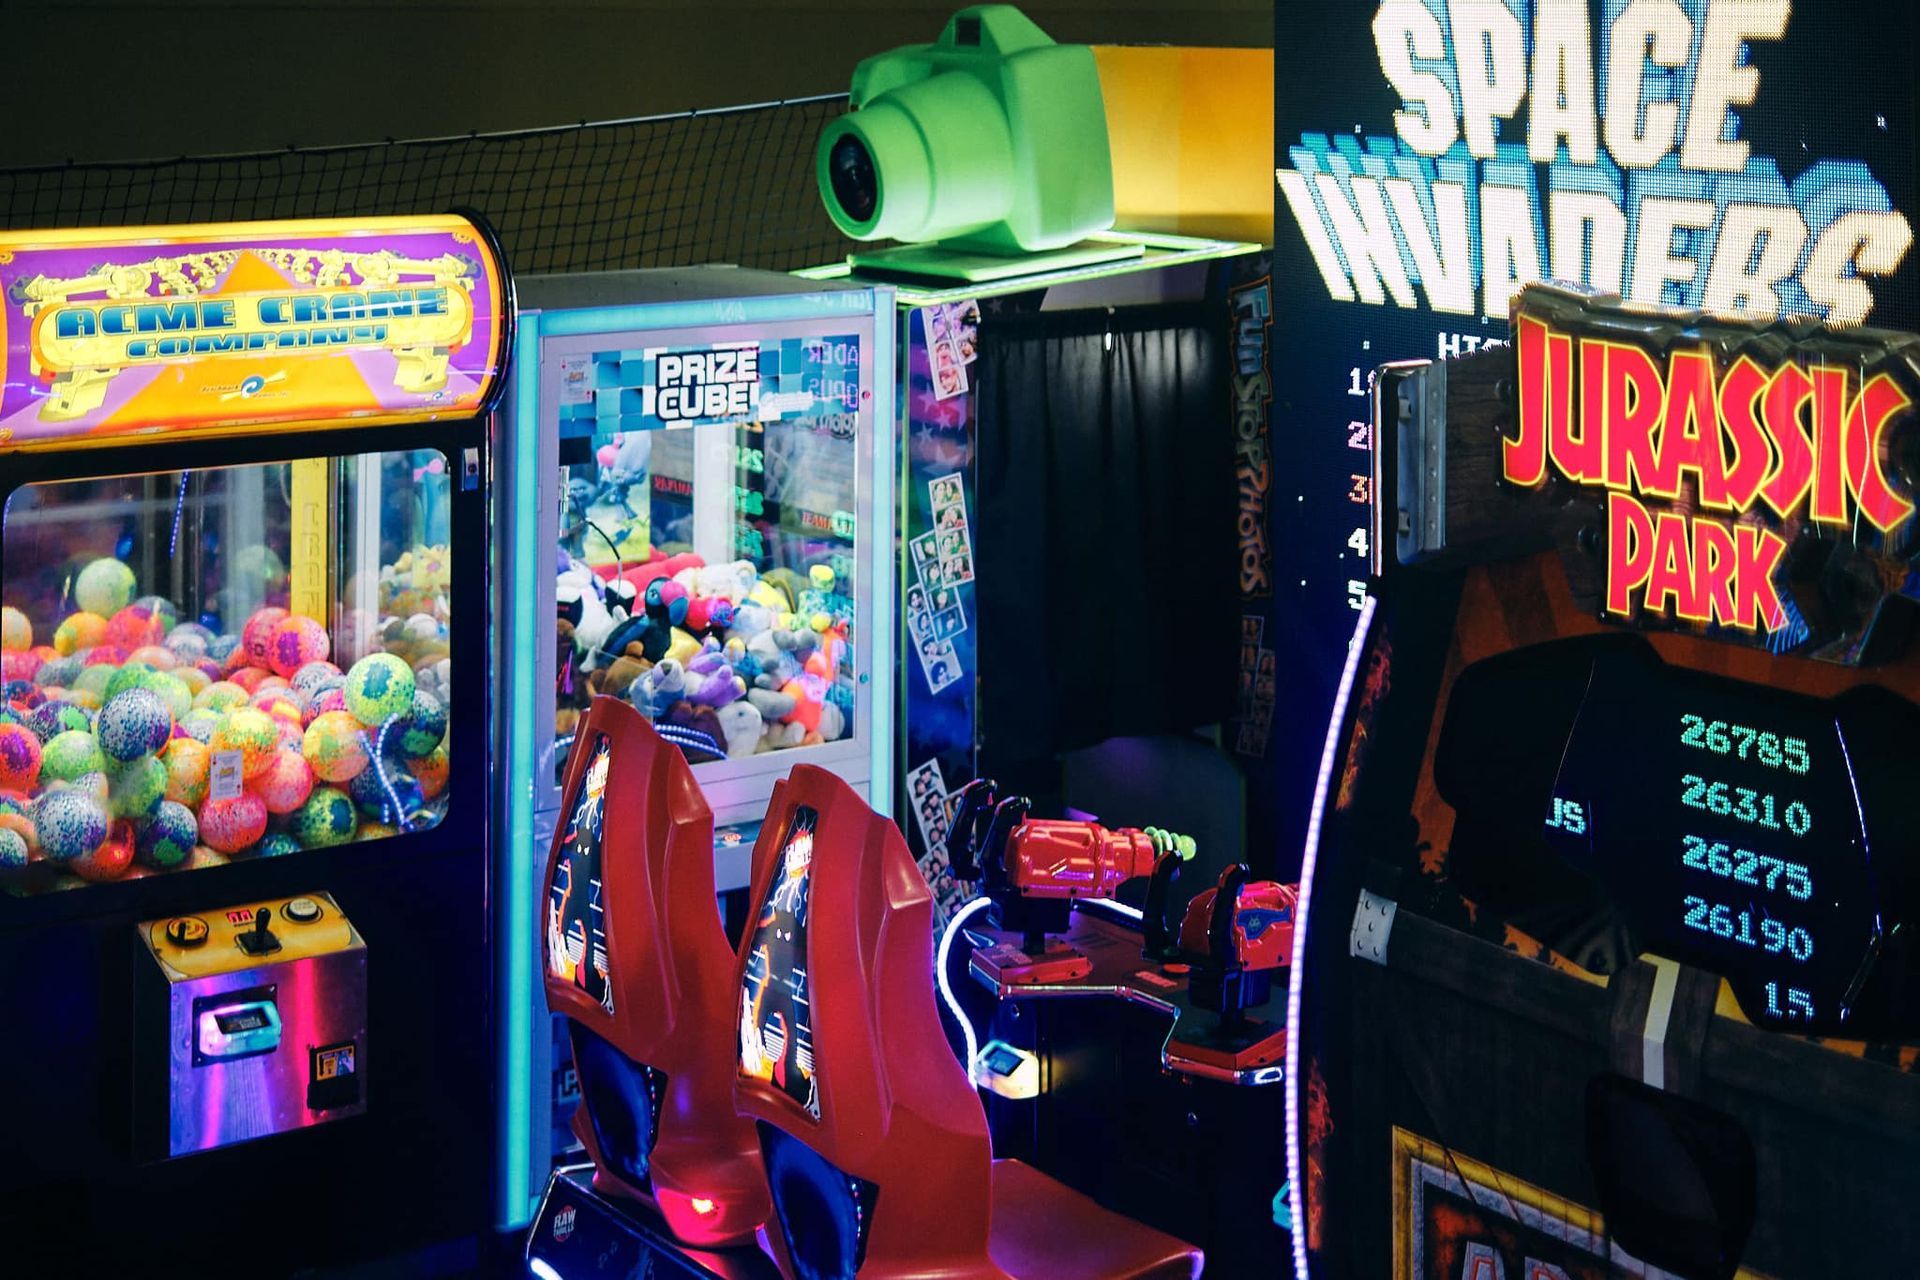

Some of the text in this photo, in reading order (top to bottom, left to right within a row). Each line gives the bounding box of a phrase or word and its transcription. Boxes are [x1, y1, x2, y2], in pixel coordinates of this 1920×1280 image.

[1371, 0, 1792, 172] SPACE
[1276, 165, 1915, 331] INVADERS
[55, 286, 449, 340] ACME CRANE
[126, 325, 388, 358] COMPANY
[659, 351, 758, 387] PRIZE
[1502, 312, 1916, 534] JURASSIC
[1606, 490, 1788, 634] PARK
[1681, 713, 1810, 775] 26785
[1681, 774, 1811, 837] 26310
[1683, 835, 1812, 900] 26275
[1684, 896, 1813, 962] 26190
